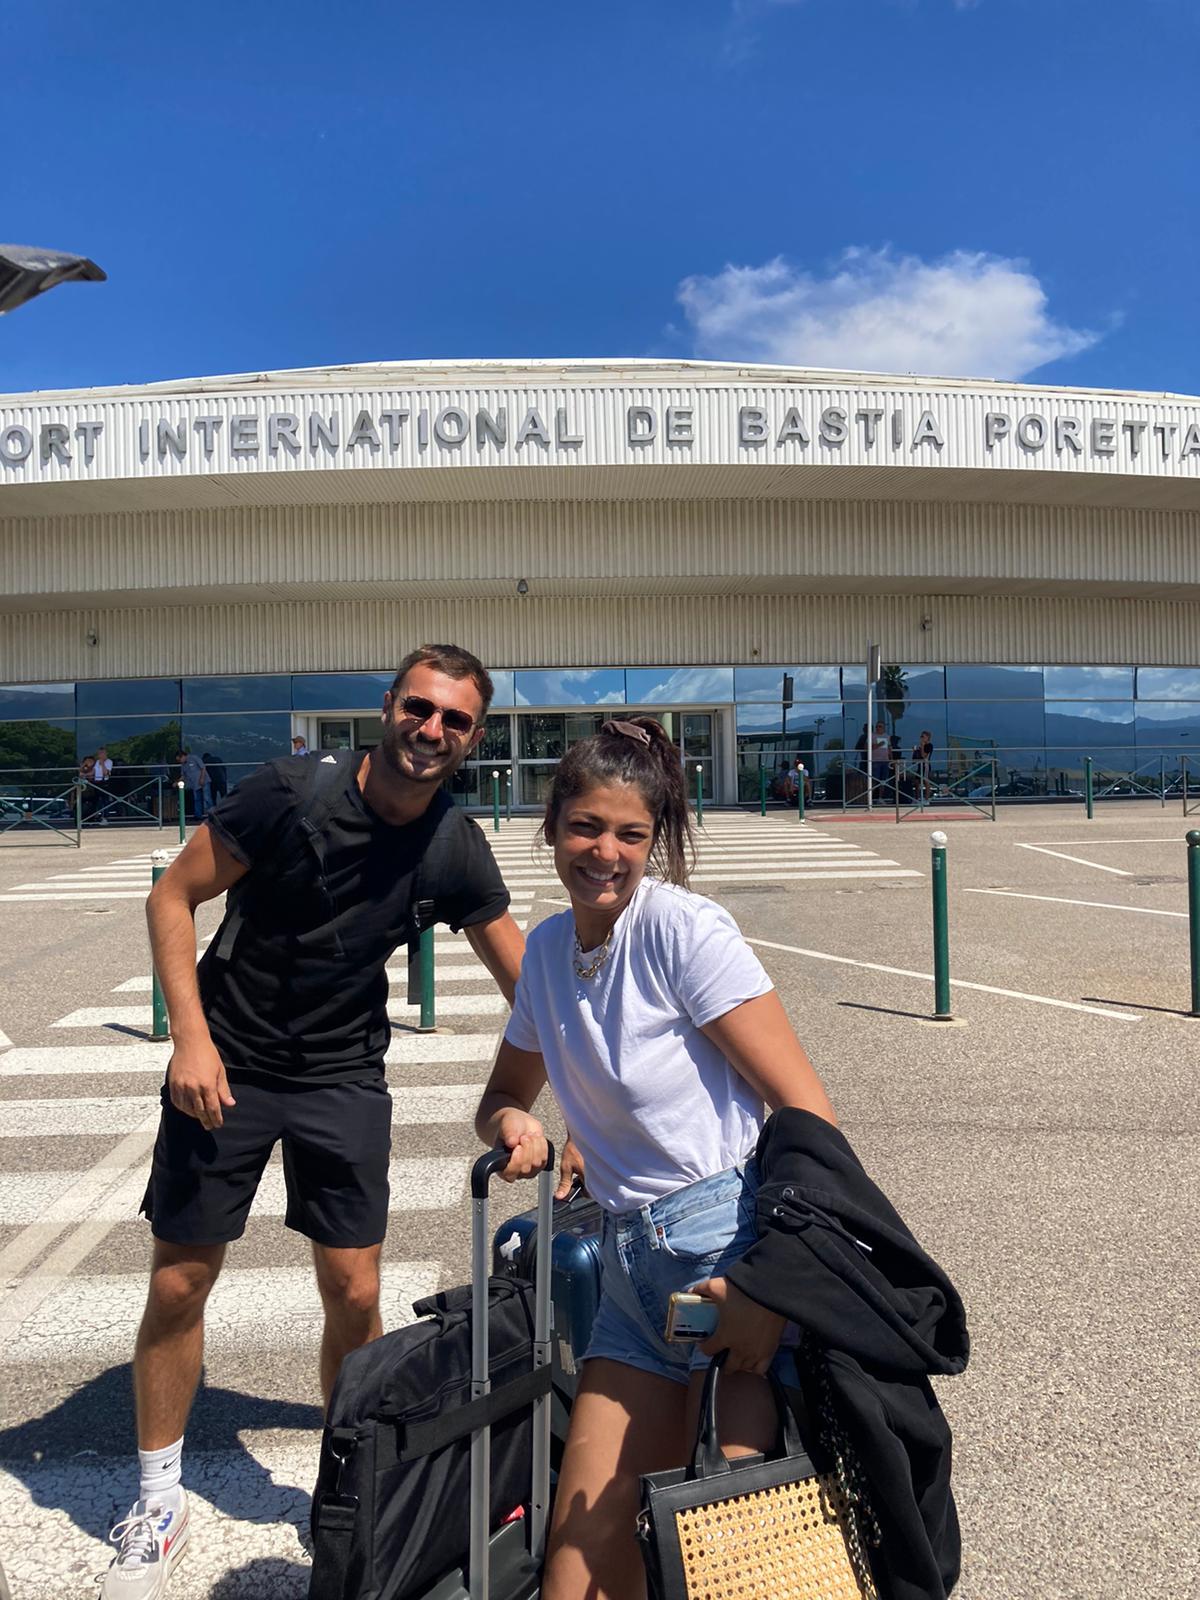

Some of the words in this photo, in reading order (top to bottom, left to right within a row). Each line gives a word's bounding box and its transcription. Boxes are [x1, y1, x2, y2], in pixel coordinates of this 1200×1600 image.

[0, 421, 104, 461] ORT
[139, 406, 584, 455] INTERNATIONAL
[628, 405, 694, 443] DE
[739, 405, 944, 446] BASTIA
